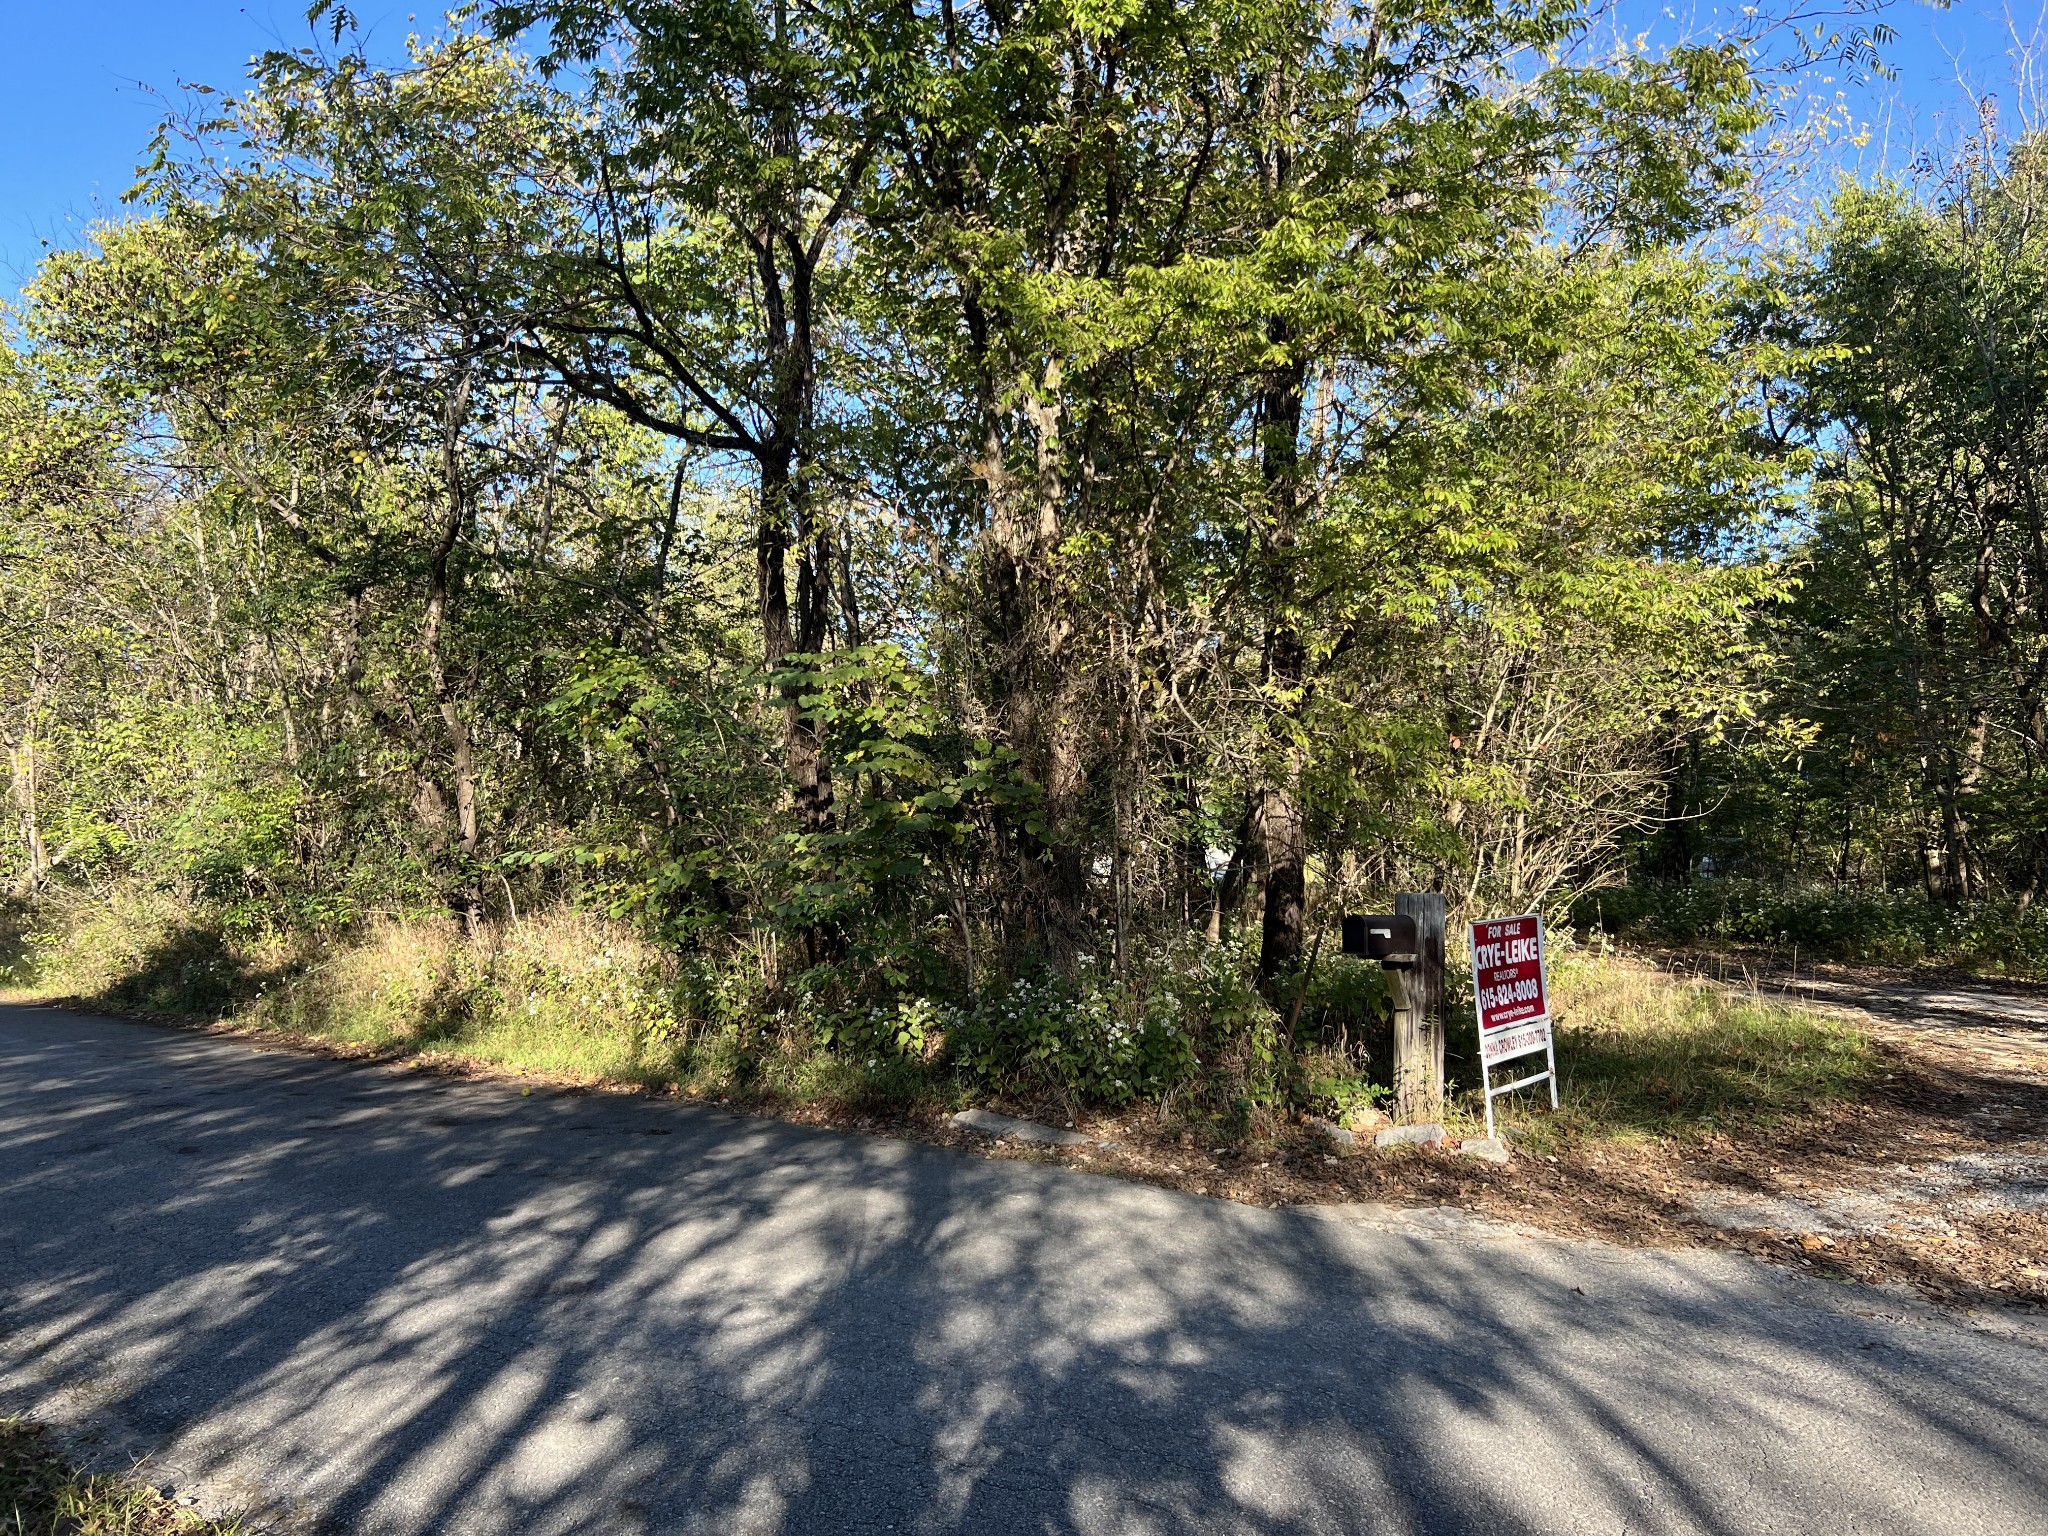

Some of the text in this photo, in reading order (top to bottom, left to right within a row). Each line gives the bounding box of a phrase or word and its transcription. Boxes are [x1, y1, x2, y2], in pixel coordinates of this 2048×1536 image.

[1487, 922, 1521, 939] FOR SALE
[1475, 937, 1538, 970] CRYE-LEIKE
[1481, 978, 1539, 1010] 615-824-8008
[1490, 1004, 1535, 1022] www.crye-leike.com
